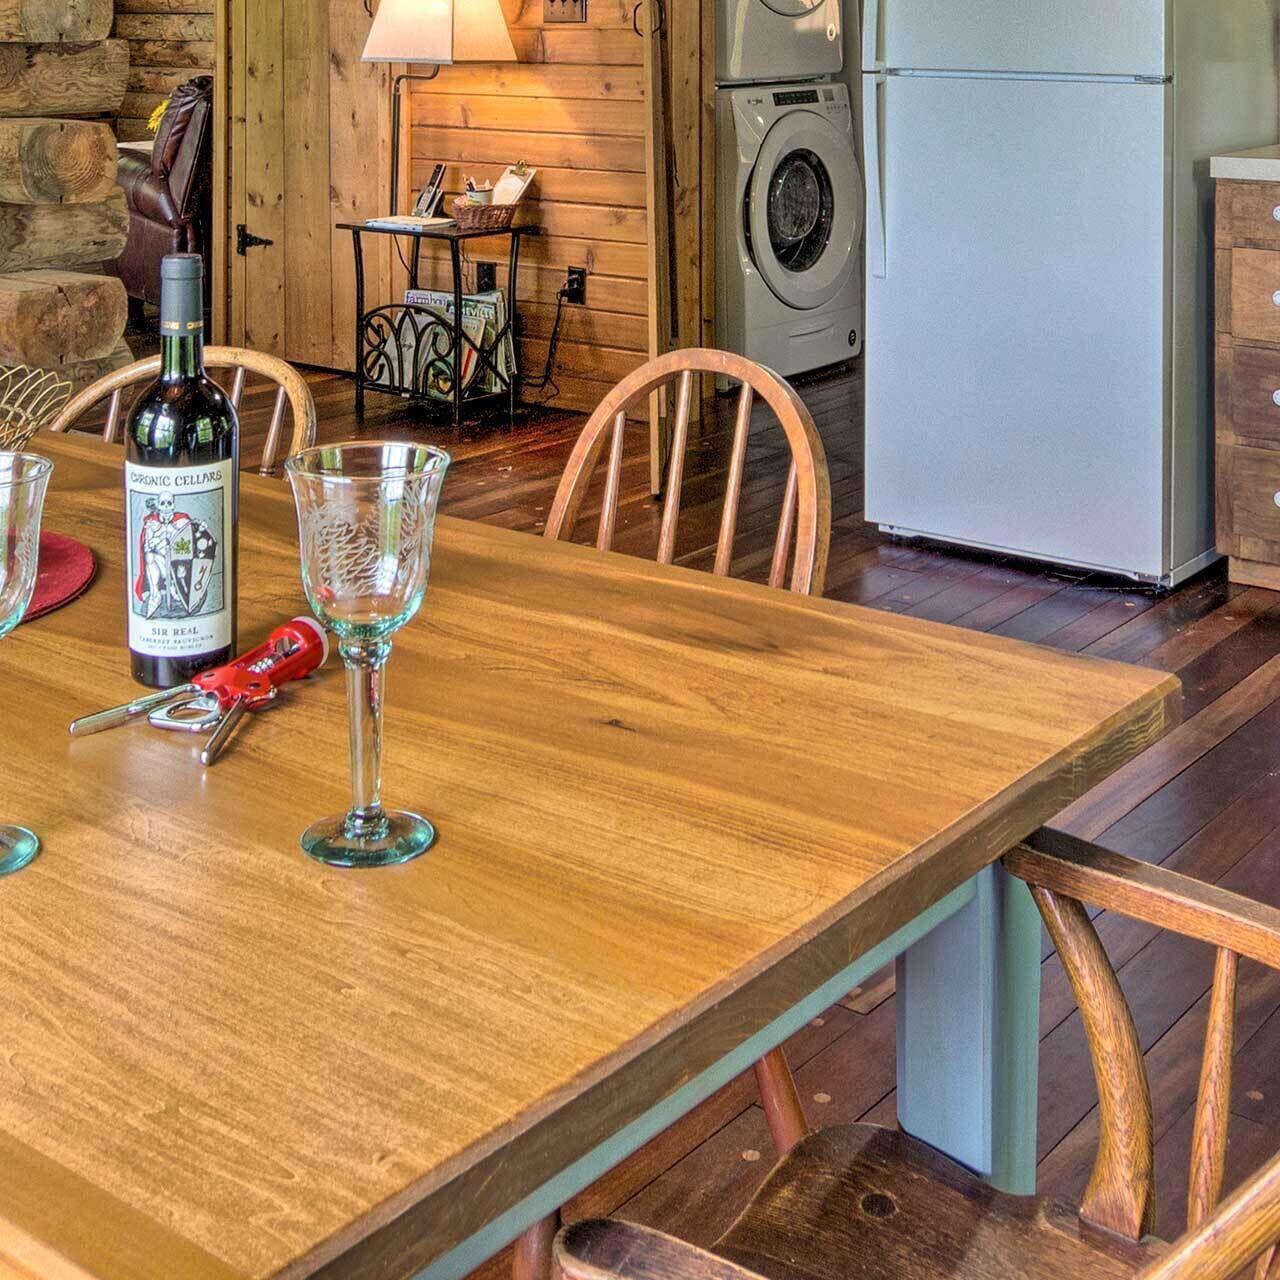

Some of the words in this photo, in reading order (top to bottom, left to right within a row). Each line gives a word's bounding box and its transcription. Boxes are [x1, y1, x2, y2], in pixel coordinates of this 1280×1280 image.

[406, 292, 447, 305] farmhou
[449, 304, 494, 319] AEVILLE
[174, 470, 222, 487] CELLARS
[151, 627, 168, 636] SIR
[173, 627, 199, 636] REAL
